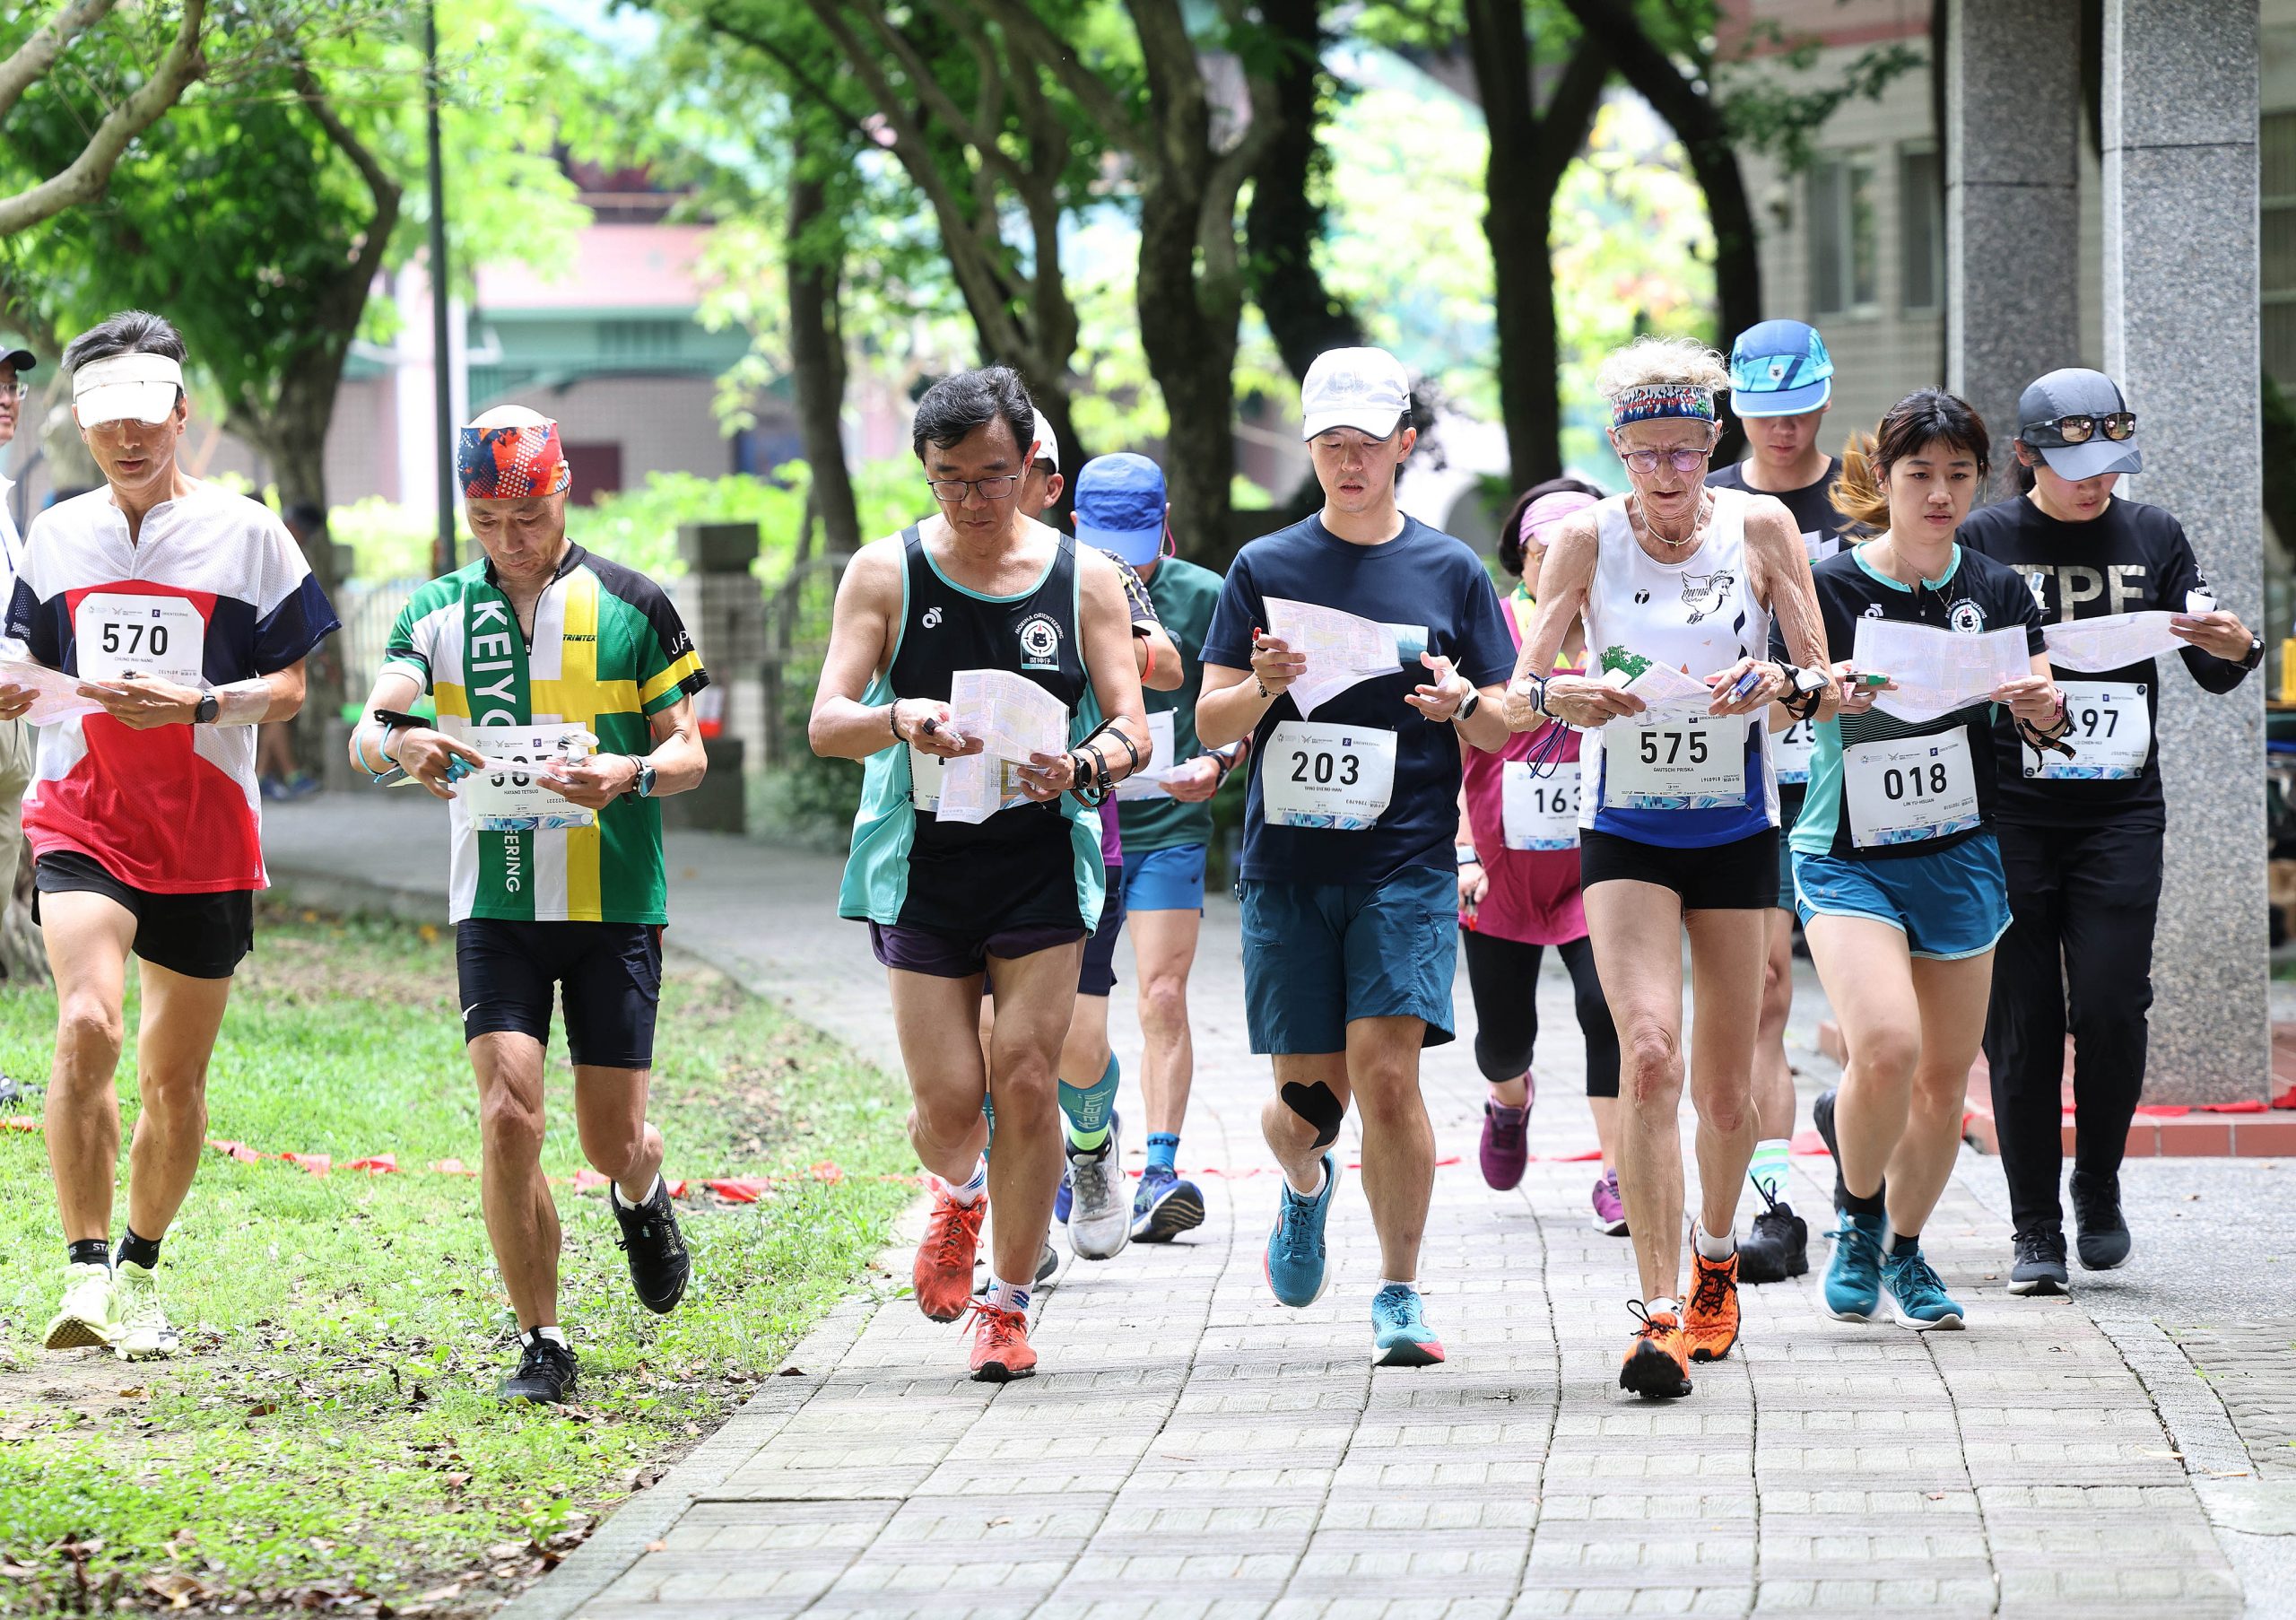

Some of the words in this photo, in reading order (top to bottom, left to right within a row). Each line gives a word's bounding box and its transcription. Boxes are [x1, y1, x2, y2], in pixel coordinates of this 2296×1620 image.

[102, 623, 168, 656] 570
[562, 634, 596, 642] TRIMTEX
[672, 631, 693, 655] JP
[2063, 708, 2118, 737] 97
[1640, 731, 1708, 764] 575
[1292, 751, 1360, 786] 203
[1884, 762, 1947, 800] 018
